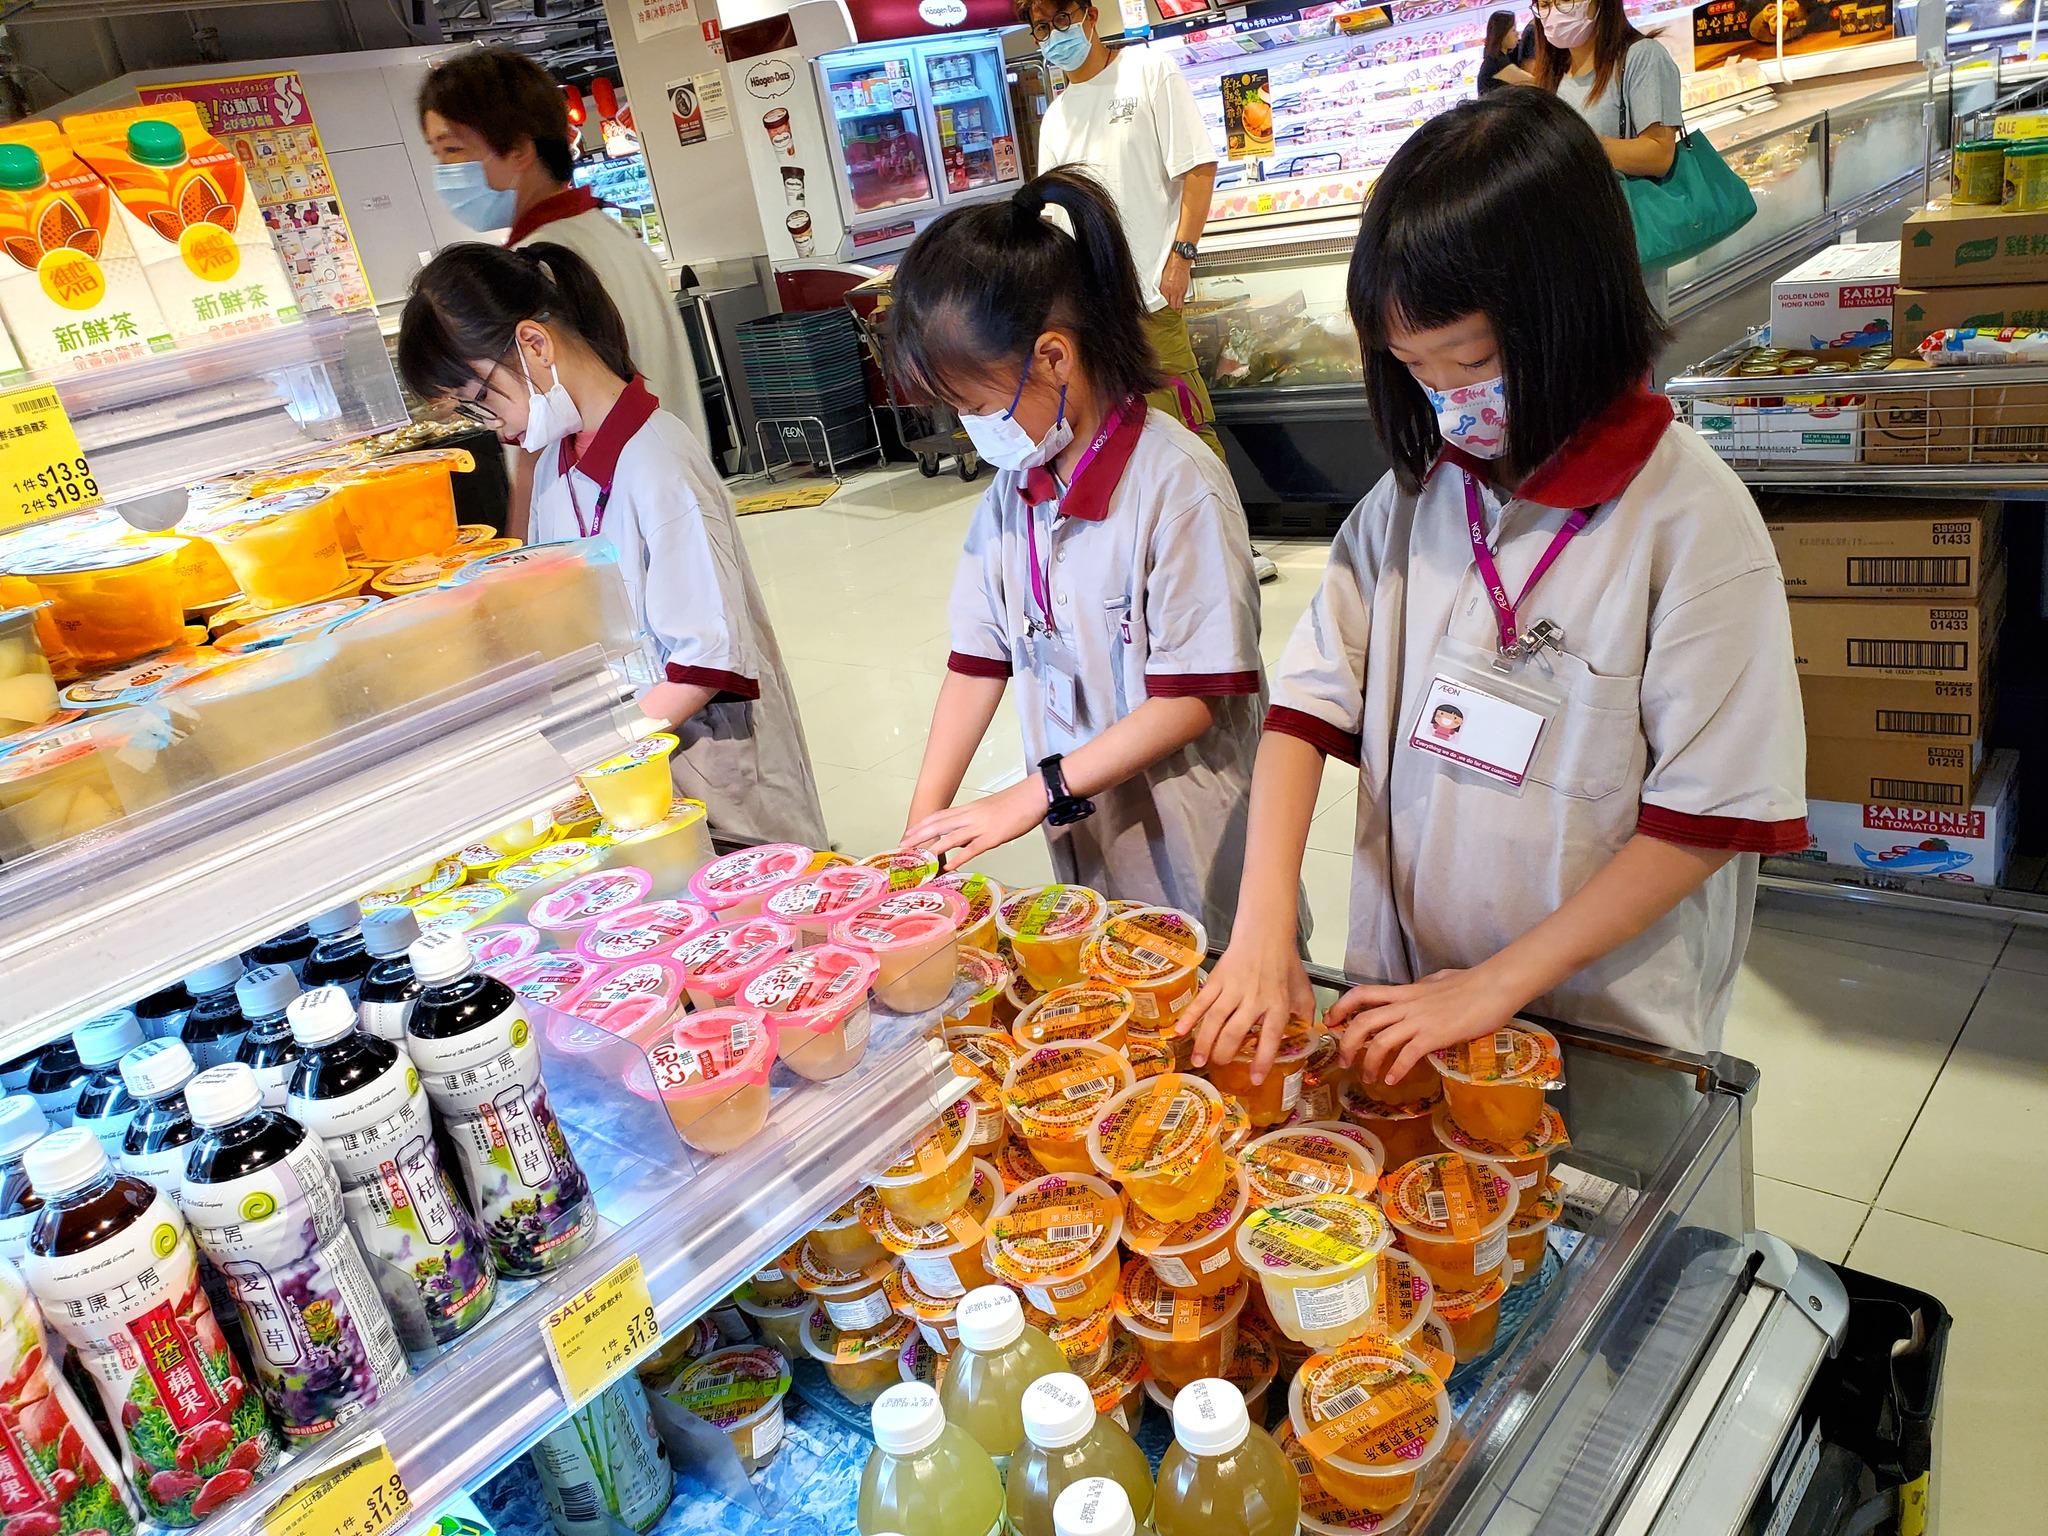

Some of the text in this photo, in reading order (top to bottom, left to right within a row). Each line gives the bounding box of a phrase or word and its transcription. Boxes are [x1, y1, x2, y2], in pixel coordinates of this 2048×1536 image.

[1997, 121, 2016, 135] SALE
[192, 283, 269, 322] 新鮮茶
[1777, 293, 1807, 301] GOLDEN
[1843, 286, 1897, 300] SARDI
[1853, 298, 1893, 306] TOMATO
[52, 311, 138, 353] 新鮮茶
[37, 457, 90, 488] $13.9
[47, 478, 99, 508] $19.9
[1932, 534, 1970, 545] 01433
[1934, 524, 1970, 533] 38900
[1930, 620, 1968, 630] 01433
[1931, 610, 1967, 619] 38900
[1935, 687, 1972, 697] 01215
[1415, 740, 1442, 754] Everything
[1929, 748, 1963, 757] 38900
[1928, 757, 1964, 767] 01215
[1869, 805, 1981, 826] SARDINES
[1887, 820, 1938, 832] TOMATO
[1941, 826, 1979, 836] SAUCE
[880, 896, 943, 912] どっさり
[603, 974, 660, 993] どっさり
[443, 1052, 515, 1091] 健康工房
[342, 1103, 415, 1151] 健康工房
[502, 1100, 543, 1172] 夏枯草
[407, 1153, 448, 1227] 夏枯草
[1017, 1184, 1089, 1205] 桔子果肉果冻
[65, 1266, 160, 1319] 健康工房
[243, 1272, 289, 1352] 夏枯草
[550, 1288, 597, 1328] SALE
[584, 1291, 623, 1325] 夏枯草飲料
[627, 1307, 655, 1336] $7.9
[623, 1320, 658, 1356] $11.9
[143, 1319, 206, 1420] 山楂蘋果
[1323, 1404, 1380, 1440] 果肉大满足
[1364, 1414, 1439, 1462] 桔子果肉果冻
[1393, 1436, 1424, 1458] TOPVALU
[366, 1474, 401, 1511] $7.9
